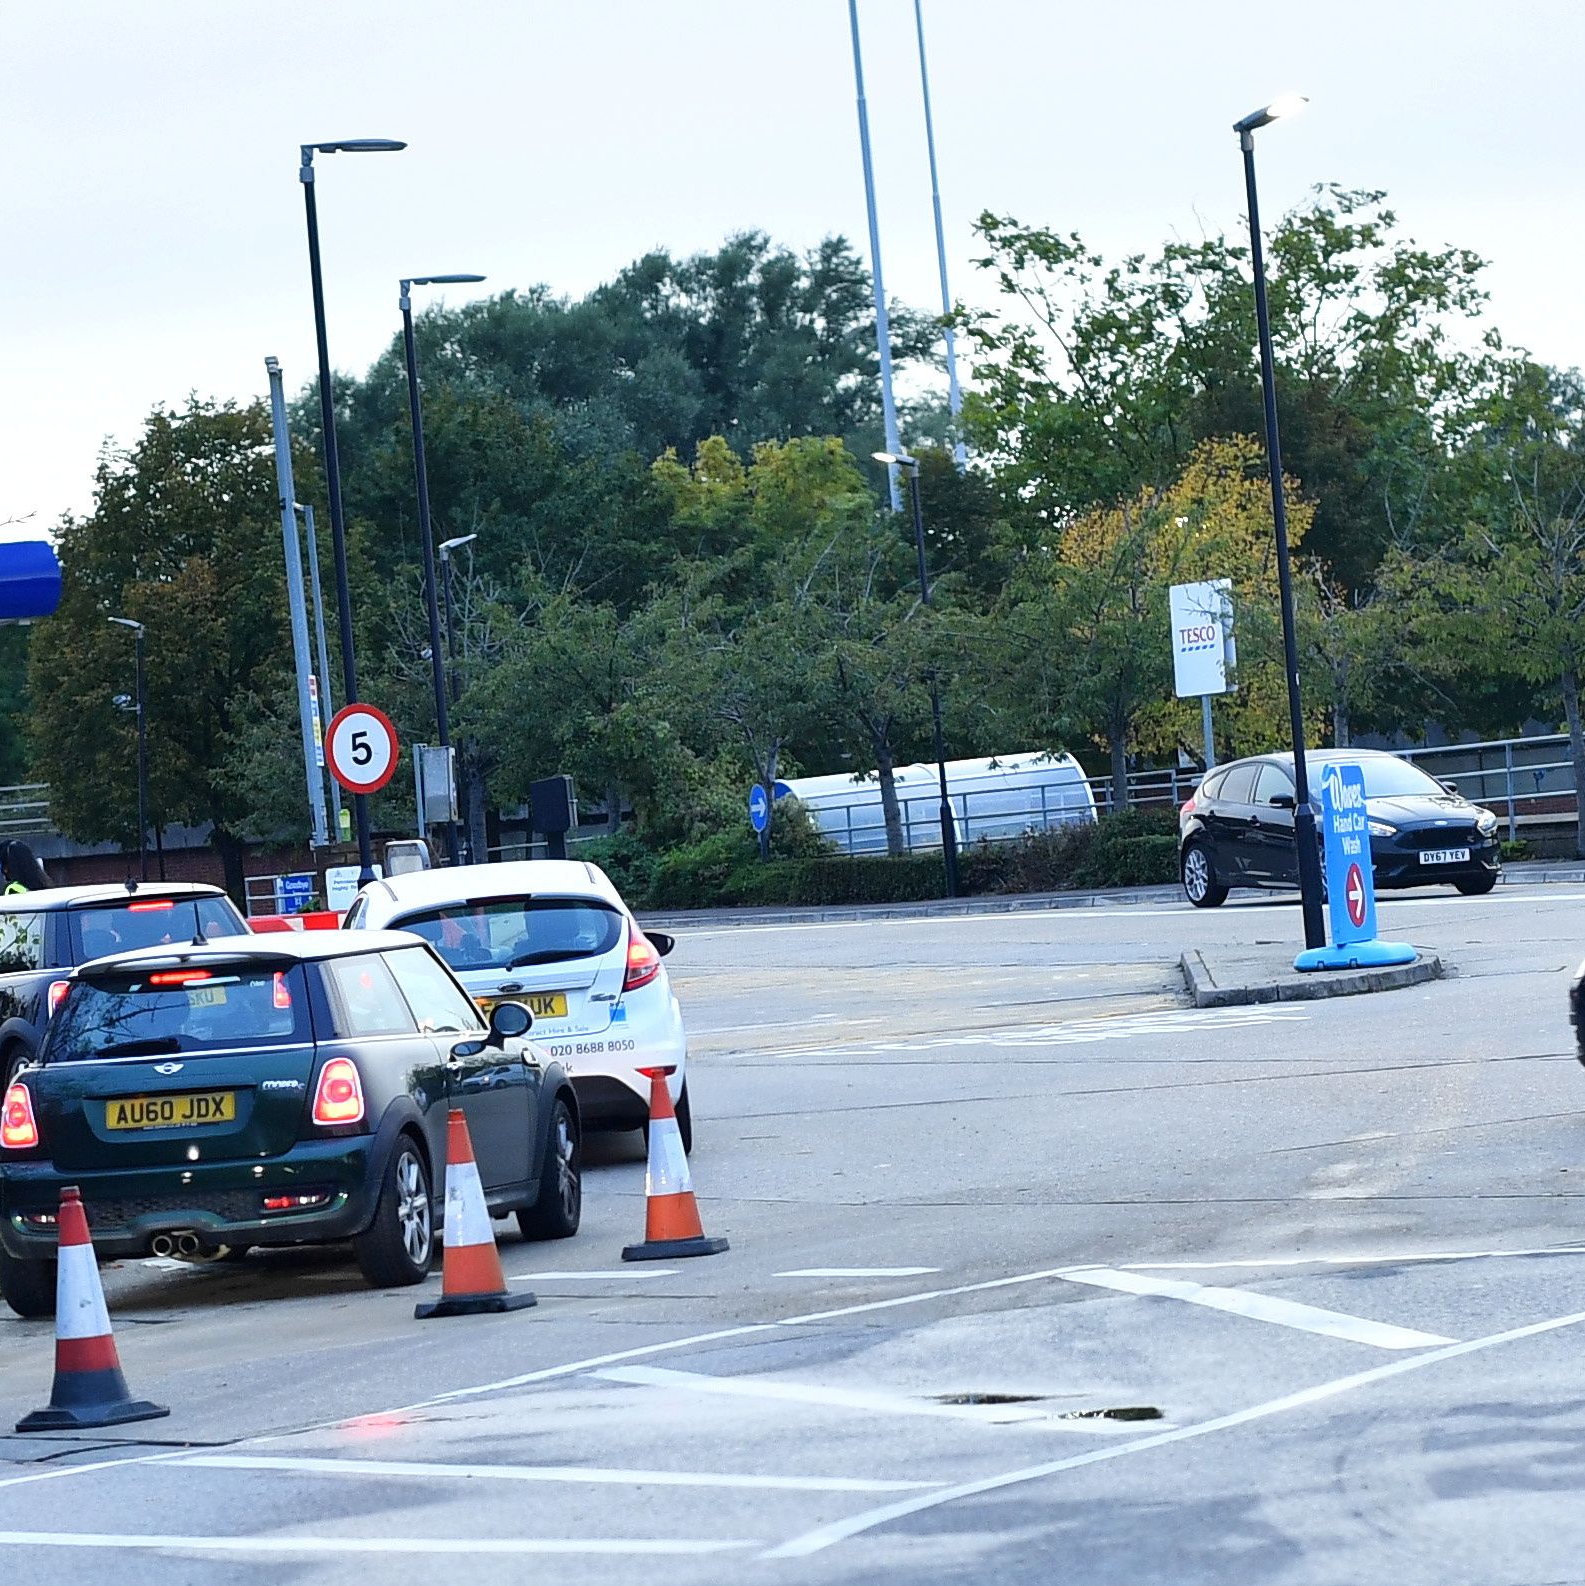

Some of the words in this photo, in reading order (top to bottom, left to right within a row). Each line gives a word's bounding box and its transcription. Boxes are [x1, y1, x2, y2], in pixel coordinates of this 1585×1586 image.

[1179, 626, 1215, 644] TESCO
[351, 731, 373, 765] 5
[1333, 812, 1352, 833] Hand
[1353, 812, 1365, 831] Car
[1342, 834, 1362, 856] Wash
[1423, 852, 1447, 863] DY67
[523, 997, 556, 1015] UK
[551, 1044, 573, 1057] 020
[576, 1041, 604, 1055] 8688
[607, 1039, 635, 1052] 8050
[116, 1099, 174, 1124] AU60
[182, 1096, 225, 1119] JDX
